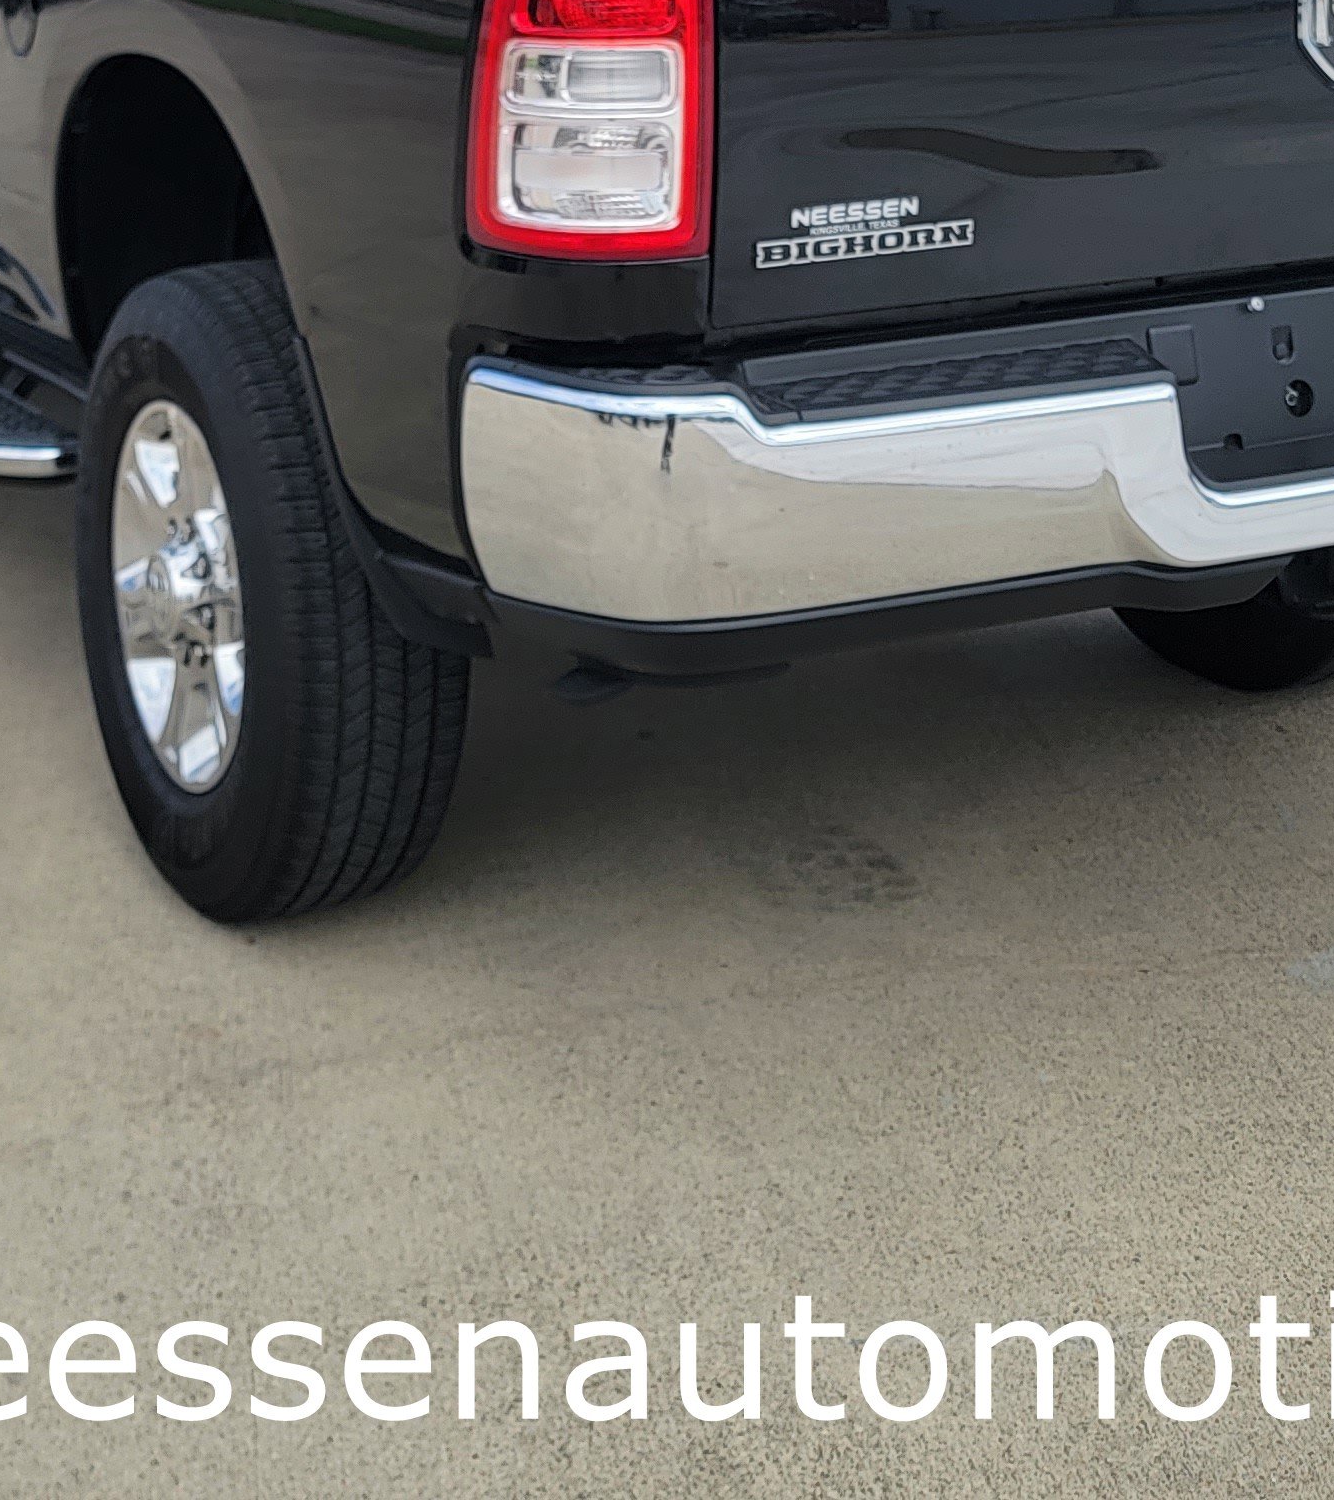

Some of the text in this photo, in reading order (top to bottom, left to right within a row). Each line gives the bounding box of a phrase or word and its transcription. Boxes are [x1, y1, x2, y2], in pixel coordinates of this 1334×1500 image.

[790, 196, 919, 229] NEESSEN
[868, 218, 900, 231] TEXAS
[755, 218, 975, 269] BIGHORN
